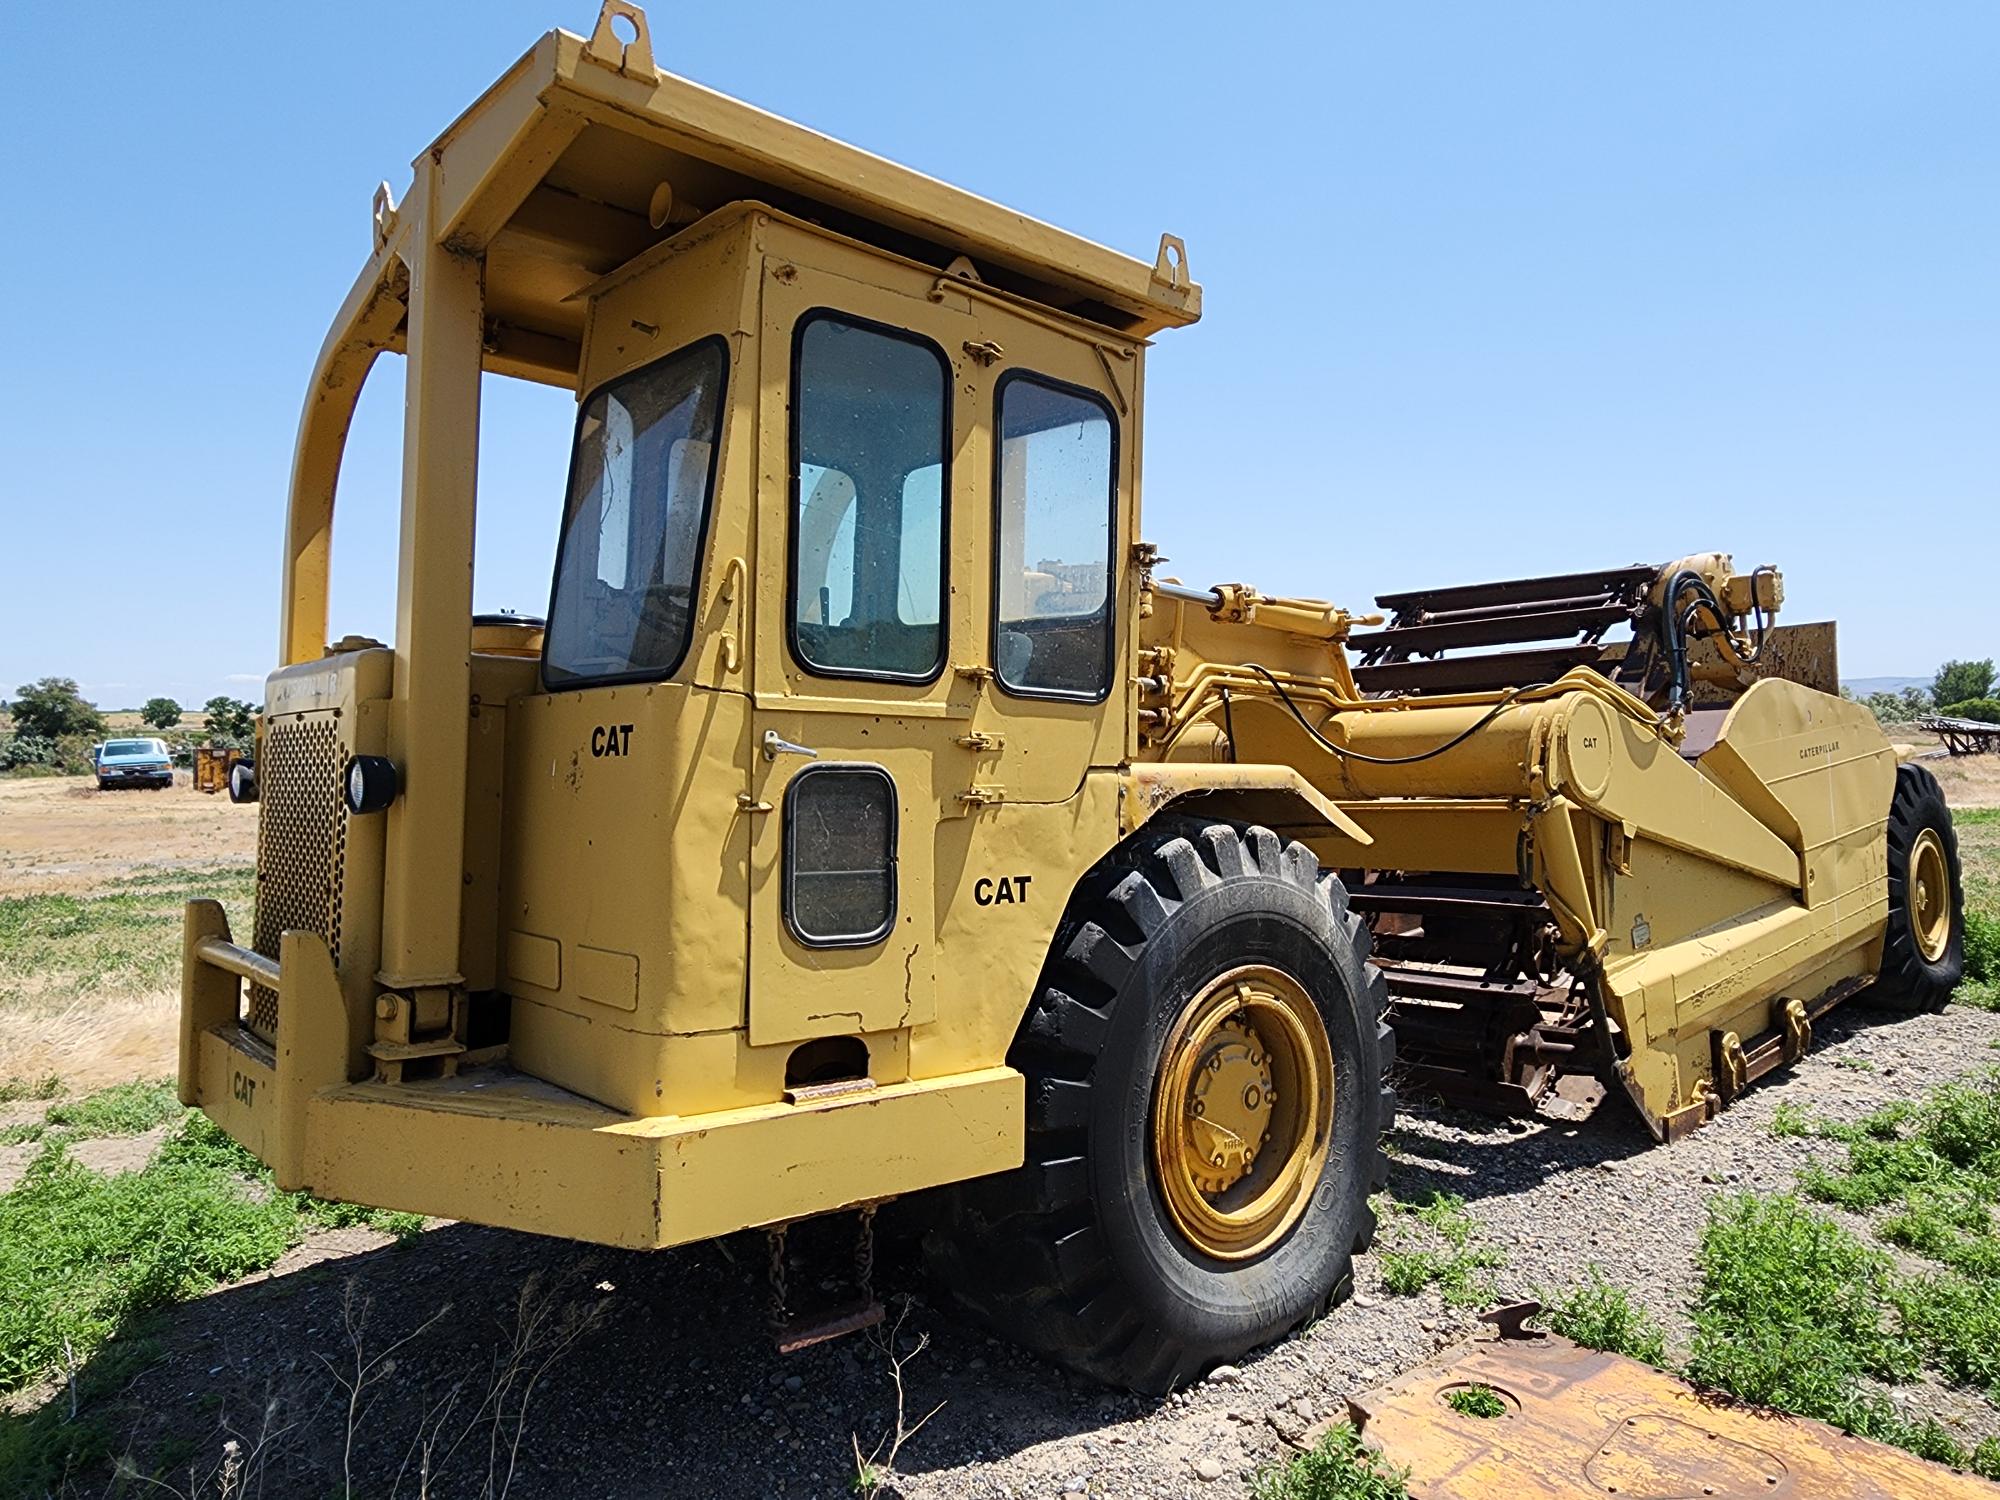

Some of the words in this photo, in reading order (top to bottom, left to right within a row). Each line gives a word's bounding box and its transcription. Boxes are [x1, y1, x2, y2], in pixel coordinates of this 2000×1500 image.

[591, 724, 634, 758] CAT
[1583, 737, 1598, 749] CAT
[1799, 741, 1840, 759] CATERPILLAR
[974, 875, 1032, 907] CAT
[233, 1071, 256, 1108] CAT
